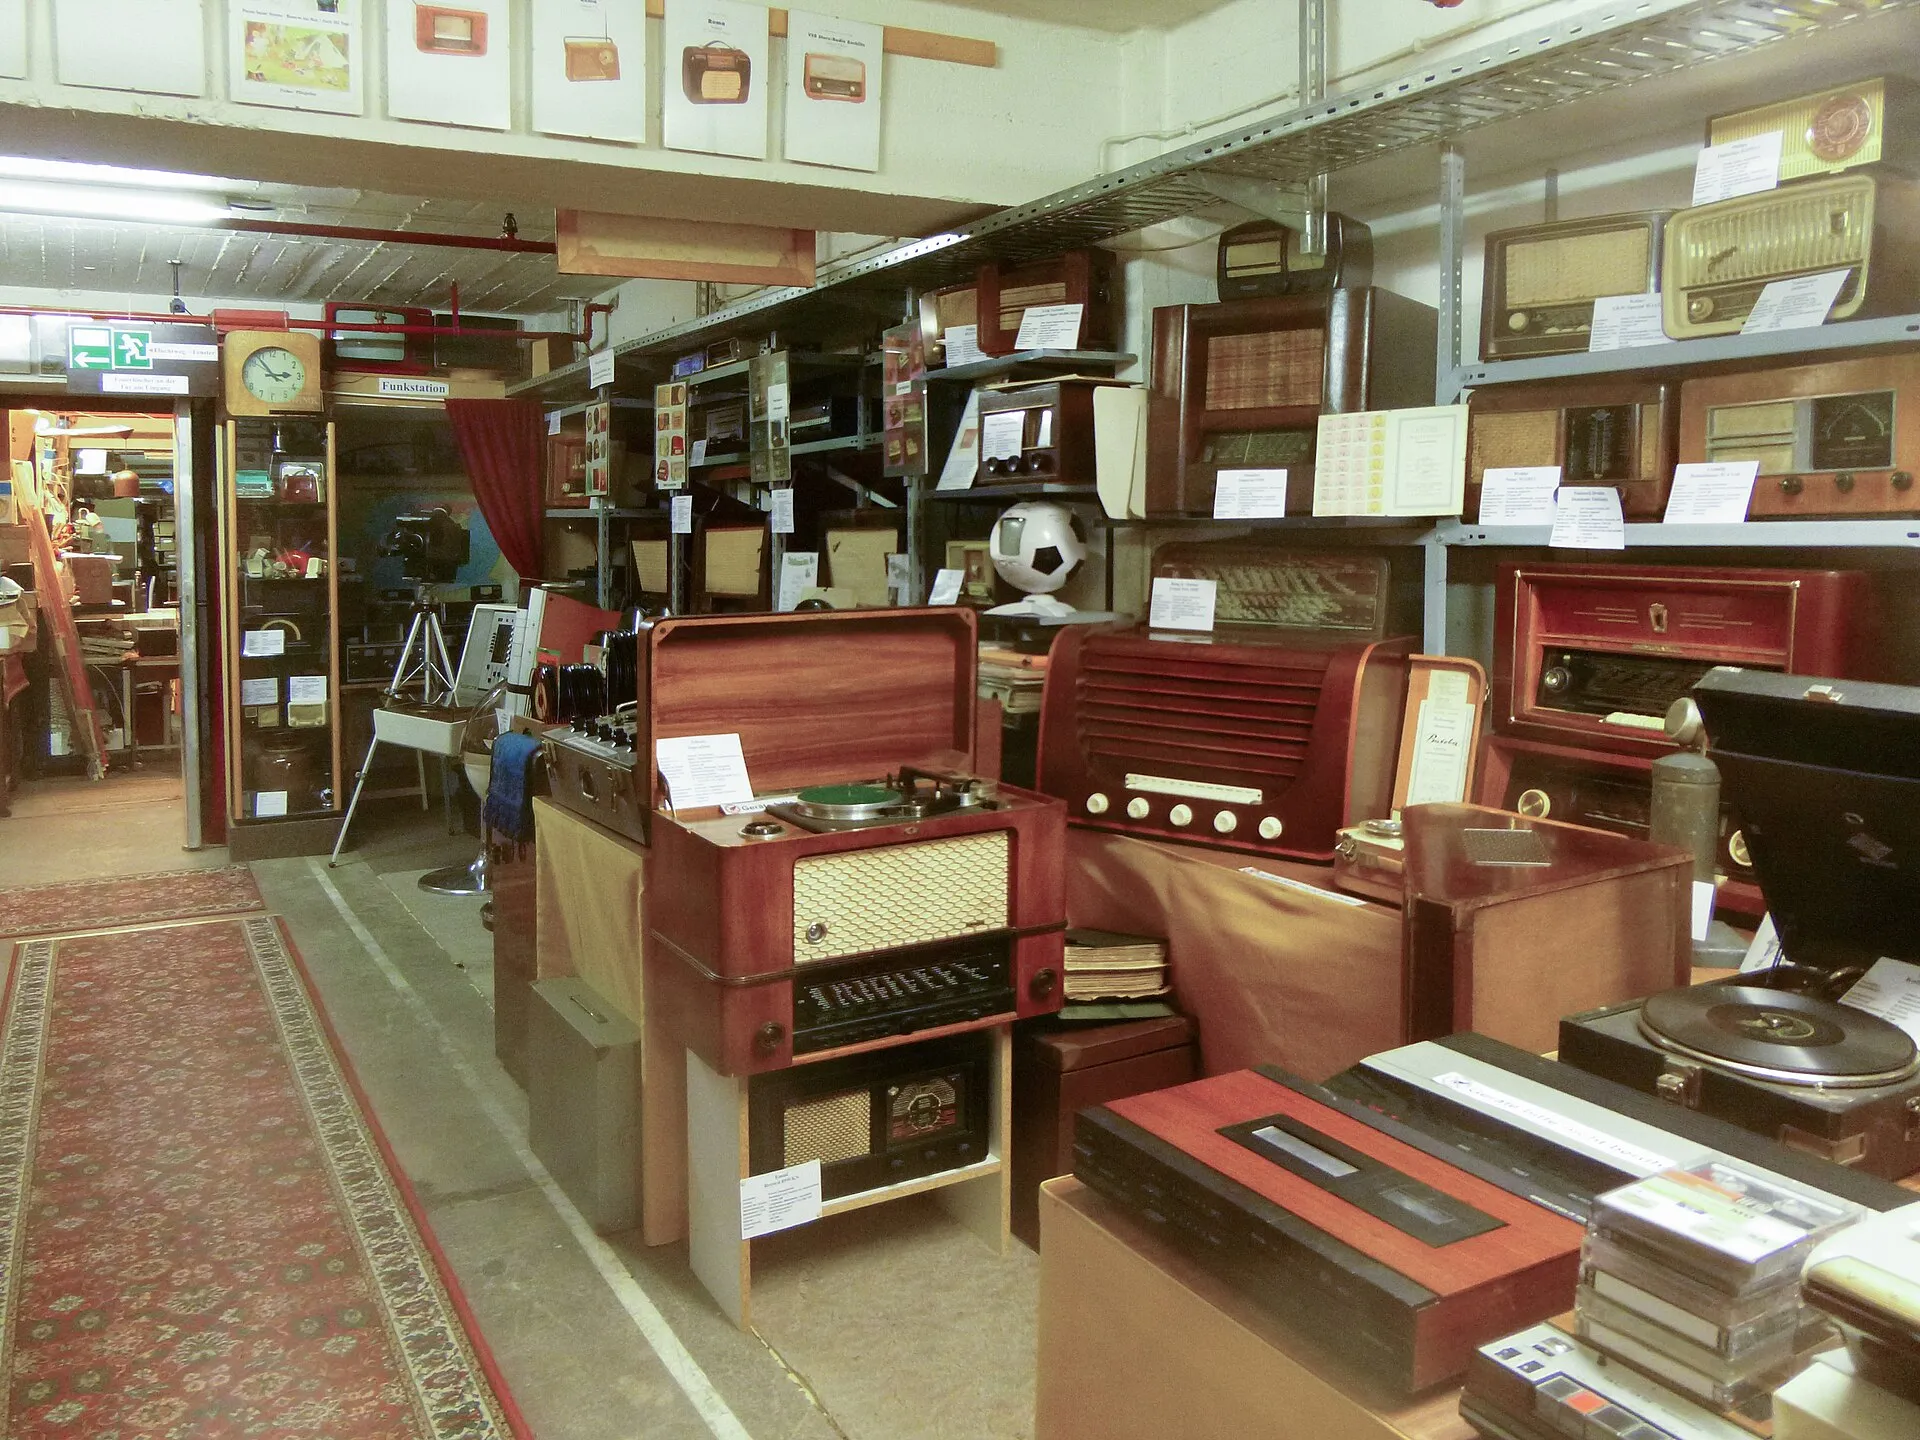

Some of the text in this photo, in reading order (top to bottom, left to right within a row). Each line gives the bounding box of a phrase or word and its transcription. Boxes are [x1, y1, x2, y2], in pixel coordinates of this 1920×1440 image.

[291, 361, 297, 369] 2
[296, 372, 302, 380] 3
[382, 381, 446, 393] Funkstation
